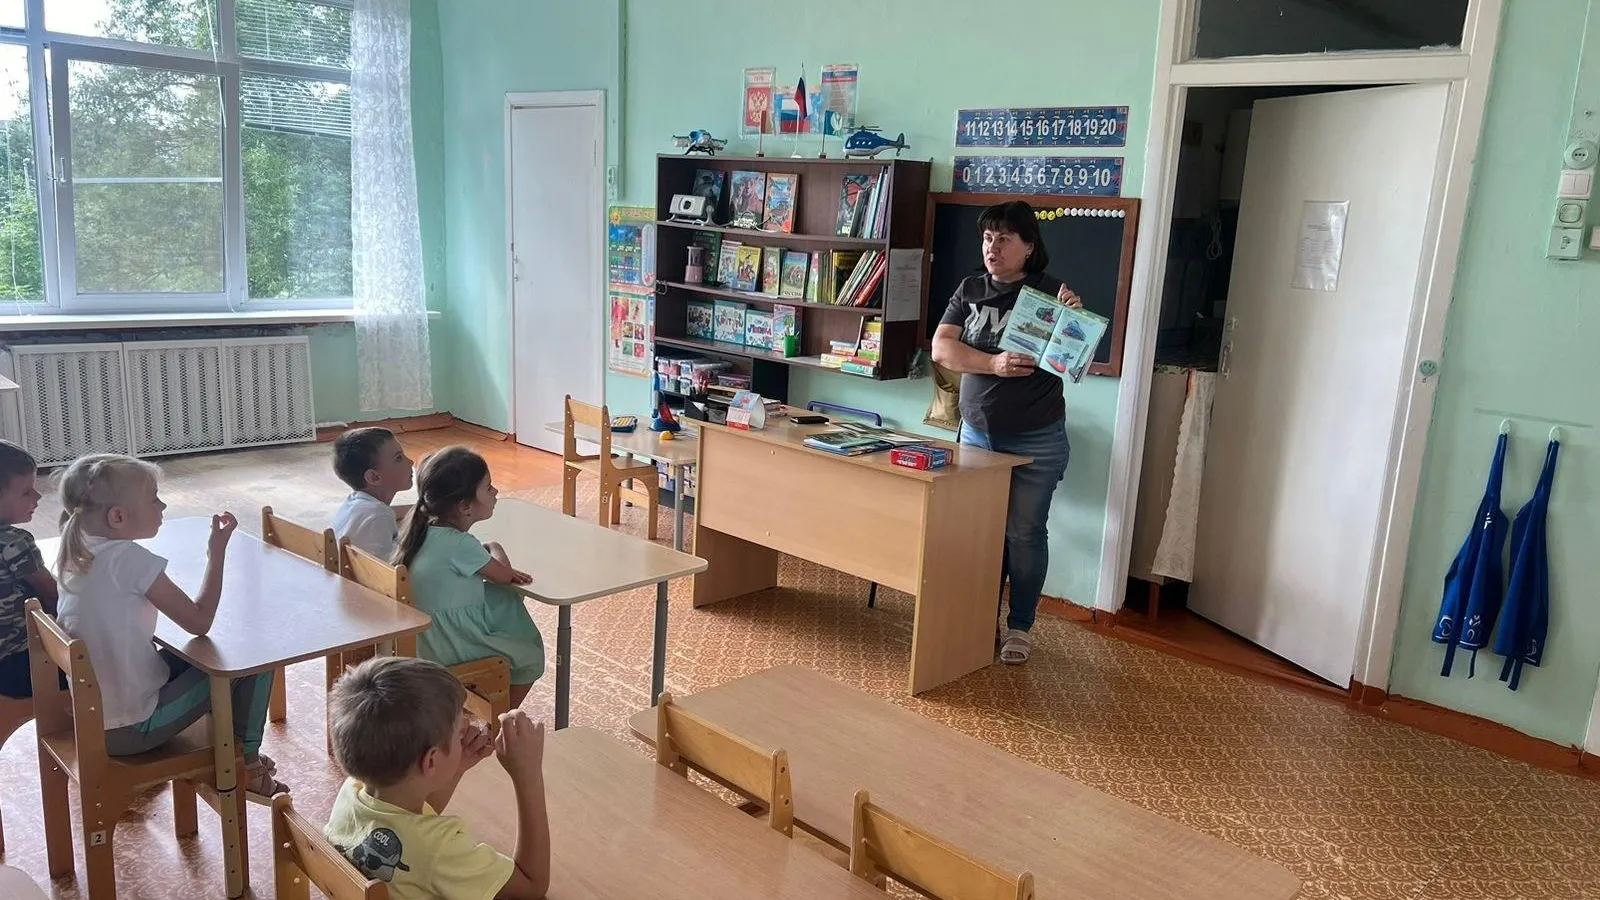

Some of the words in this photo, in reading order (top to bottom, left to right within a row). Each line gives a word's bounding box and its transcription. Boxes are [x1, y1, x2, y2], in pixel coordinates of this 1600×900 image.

[964, 121, 976, 137] 11
[978, 120, 990, 137] 12
[991, 120, 1004, 137] 13
[1005, 120, 1018, 137] 14
[1020, 120, 1033, 137] 15
[1036, 119, 1049, 136] 16
[1052, 119, 1066, 136] 17
[1068, 119, 1082, 136] 18
[1084, 118, 1098, 136] 19
[1099, 118, 1117, 136] 20
[962, 166, 971, 183] 0
[974, 166, 981, 184] 1
[985, 167, 994, 184] 2
[998, 167, 1007, 185] 3
[1011, 167, 1020, 185] 4
[1024, 167, 1033, 185] 5
[1037, 167, 1046, 185] 6
[1051, 167, 1060, 185] 7
[1063, 168, 1073, 186] 8
[1078, 168, 1088, 186] 9
[1092, 168, 1111, 187] 10
[95, 834, 102, 843] 2
[373, 831, 390, 846] COOL
